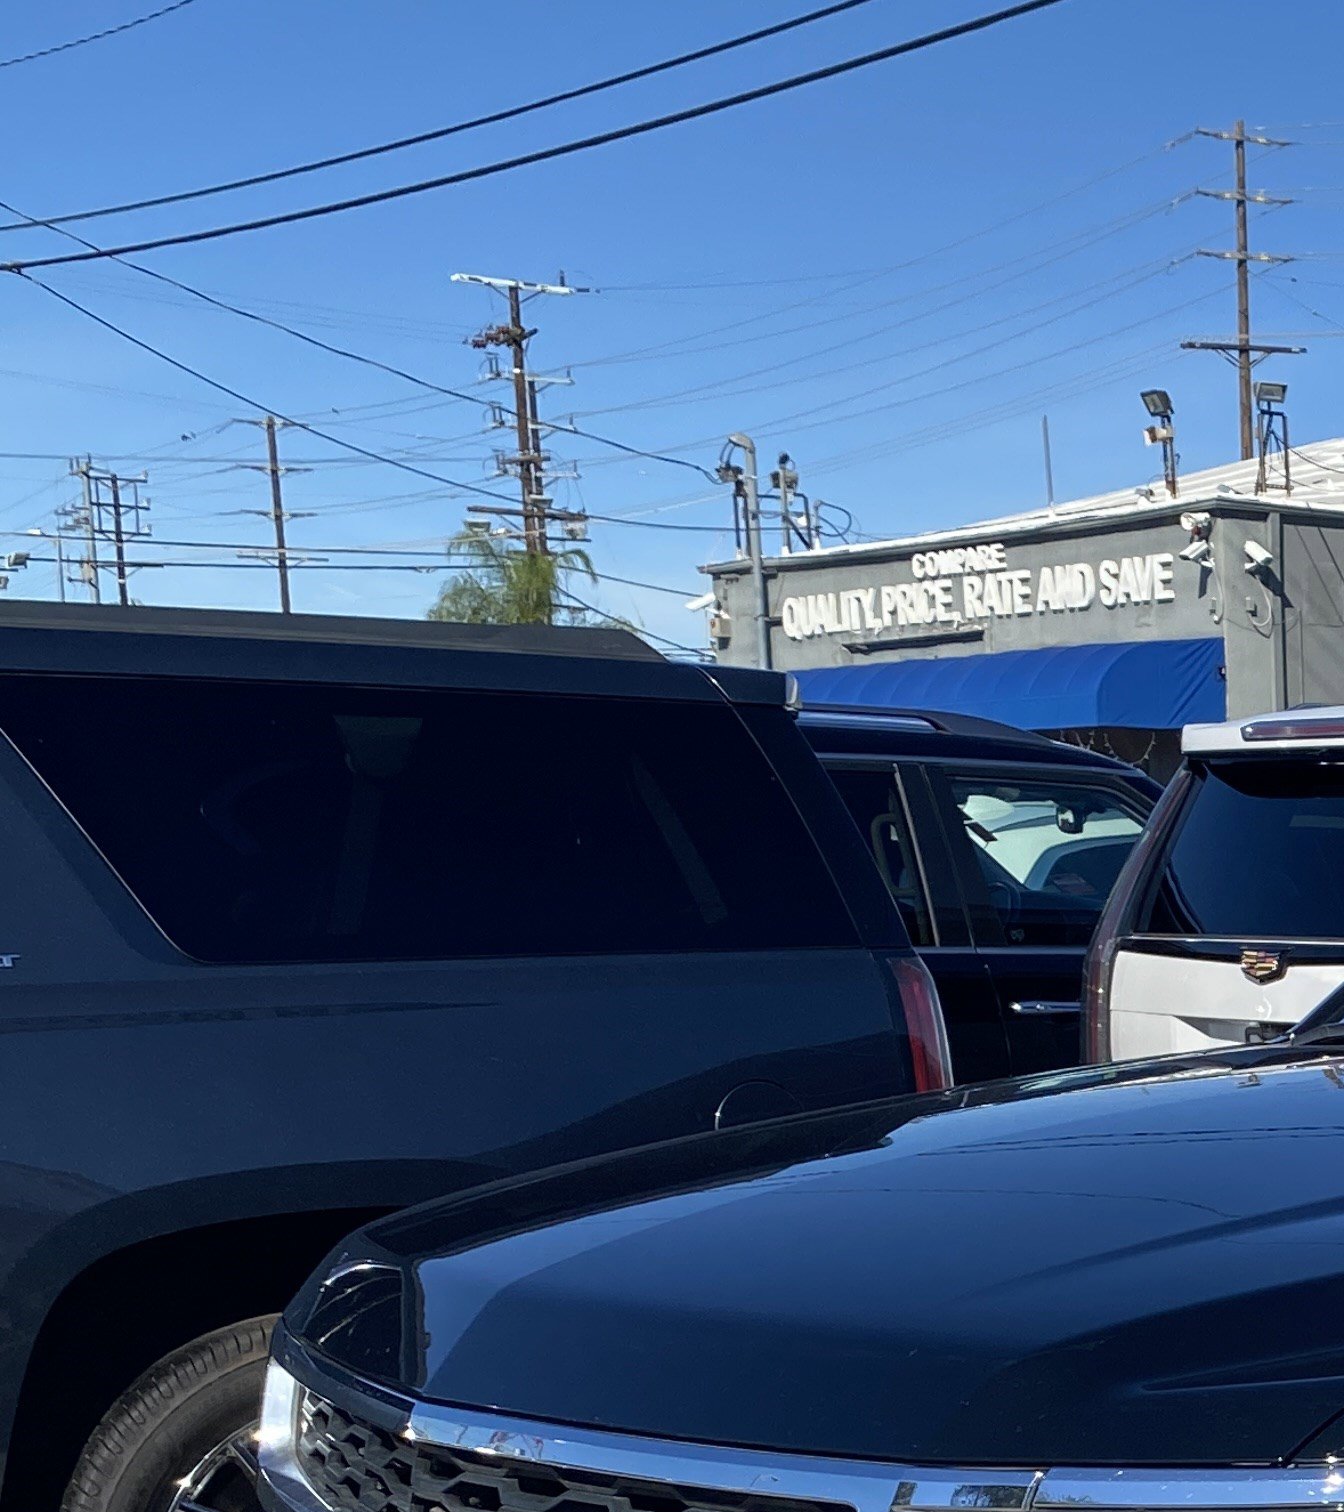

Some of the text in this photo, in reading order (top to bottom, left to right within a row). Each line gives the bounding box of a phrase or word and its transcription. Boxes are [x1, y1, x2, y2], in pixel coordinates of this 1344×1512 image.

[911, 542, 1008, 579] COMPARE
[962, 569, 1033, 618] RATE
[1036, 563, 1095, 612] AND
[1099, 552, 1176, 607] SAVE
